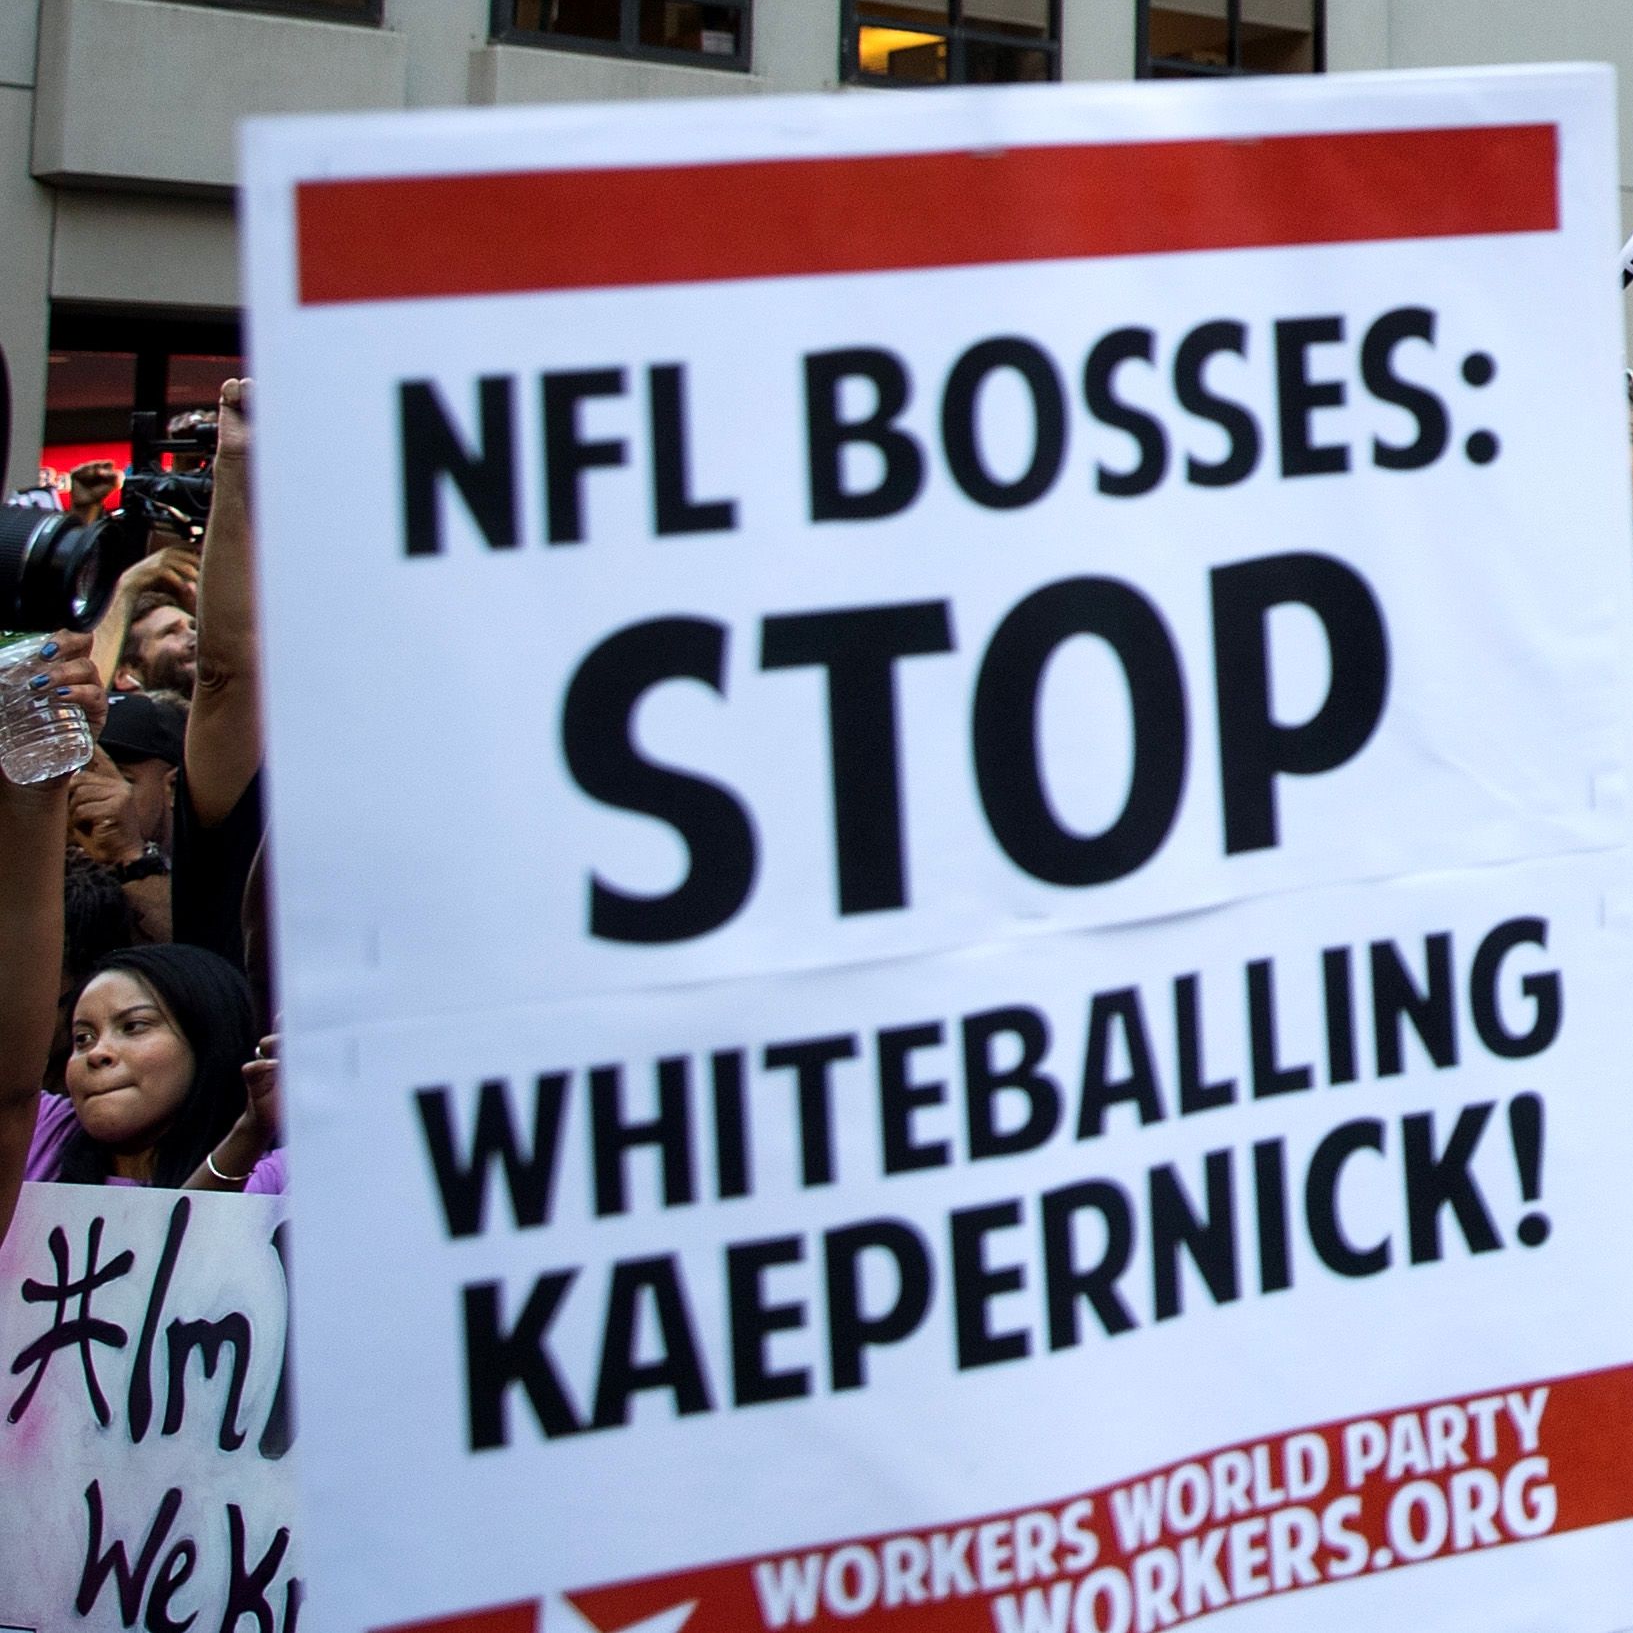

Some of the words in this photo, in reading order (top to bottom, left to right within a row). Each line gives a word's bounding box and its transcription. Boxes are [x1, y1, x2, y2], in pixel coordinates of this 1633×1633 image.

[398, 364, 735, 558] NFL
[803, 307, 1498, 523] BOSSES:
[560, 552, 1389, 946] STOP
[414, 918, 1561, 1241] WHITEBALLING
[461, 1094, 1550, 1454] KAEPERNICK!
[753, 1498, 1101, 1630] WORKERS
[1109, 1432, 1331, 1553] WORLD
[1342, 1386, 1550, 1478] PARTY
